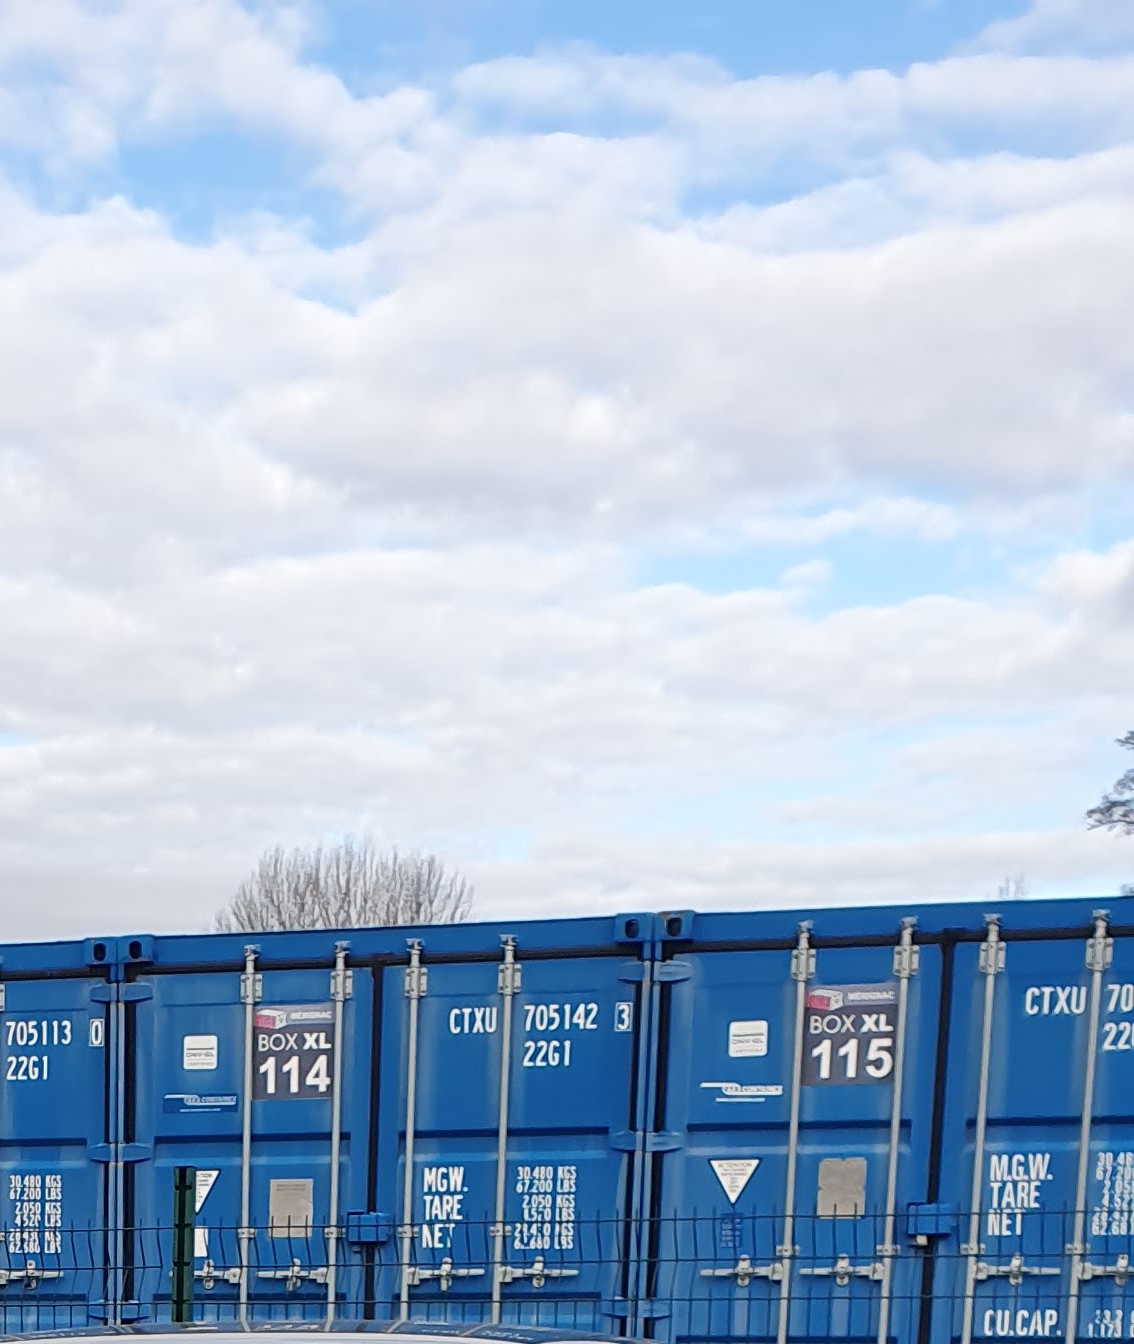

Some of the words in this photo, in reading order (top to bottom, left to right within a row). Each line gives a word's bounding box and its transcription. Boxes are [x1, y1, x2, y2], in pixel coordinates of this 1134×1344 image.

[1025, 986, 1087, 1015] CTXU
[449, 1008, 497, 1033] CTXU
[524, 1003, 598, 1030] 705142
[616, 1004, 631, 1030] 3
[809, 1015, 855, 1034] BOX
[860, 1014, 894, 1032] XL
[6, 1020, 72, 1046] 705113
[90, 1020, 103, 1046] 0
[258, 1033, 298, 1052] BOX
[303, 1032, 332, 1050] XL
[522, 1040, 570, 1067] 22G1
[811, 1038, 893, 1078] 115
[6, 1056, 48, 1080] 22G1
[259, 1055, 331, 1094] 114
[424, 1166, 468, 1192] MGW.
[518, 1166, 554, 1180] 30.480
[558, 1166, 576, 1180] KGS
[990, 1154, 1053, 1181] M.G.W.
[10, 1175, 41, 1188] 30.480
[46, 1175, 62, 1188] KGS
[10, 1188, 41, 1200] 67.200
[45, 1188, 62, 1200] LBS
[516, 1180, 552, 1193] 67.200
[556, 1180, 576, 1193] LBS
[424, 1195, 463, 1220] TARE
[522, 1194, 552, 1208] 2.050
[556, 1194, 575, 1208] KGS
[991, 1182, 1040, 1208] TARE
[45, 1202, 62, 1214] KGS
[45, 1214, 61, 1227] LBS
[422, 1223, 455, 1248] NET
[988, 1210, 1022, 1236] NET
